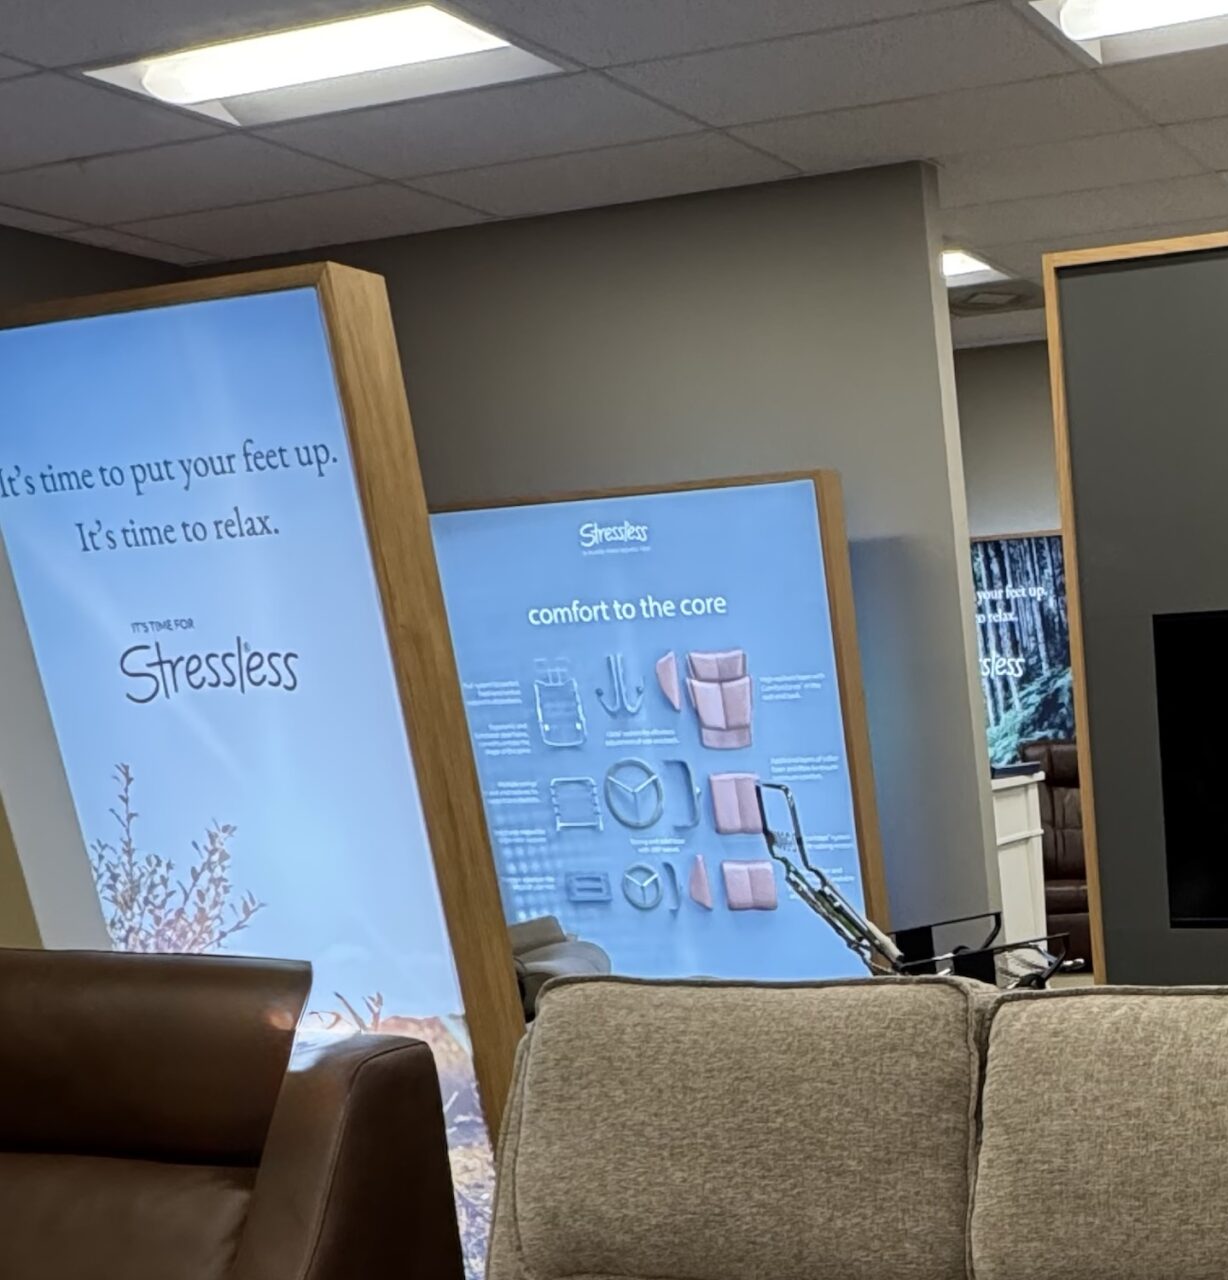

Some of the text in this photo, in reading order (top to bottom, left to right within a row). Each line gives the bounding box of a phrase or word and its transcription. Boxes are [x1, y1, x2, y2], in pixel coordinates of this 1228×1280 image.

[40, 464, 95, 493] time
[99, 465, 125, 487] to
[130, 459, 175, 496] put
[178, 453, 236, 491] your
[242, 438, 290, 473] feet
[294, 443, 338, 477] up.
[75, 506, 279, 552] It's time to relax.
[579, 520, 649, 547] Stressless
[528, 594, 727, 626] comfort to the core
[976, 589, 1003, 606] your
[1006, 584, 1027, 599] feet
[150, 620, 173, 632] TIME
[174, 618, 195, 629] FOR
[120, 636, 298, 703] Stressless
[979, 650, 1026, 678] sless
